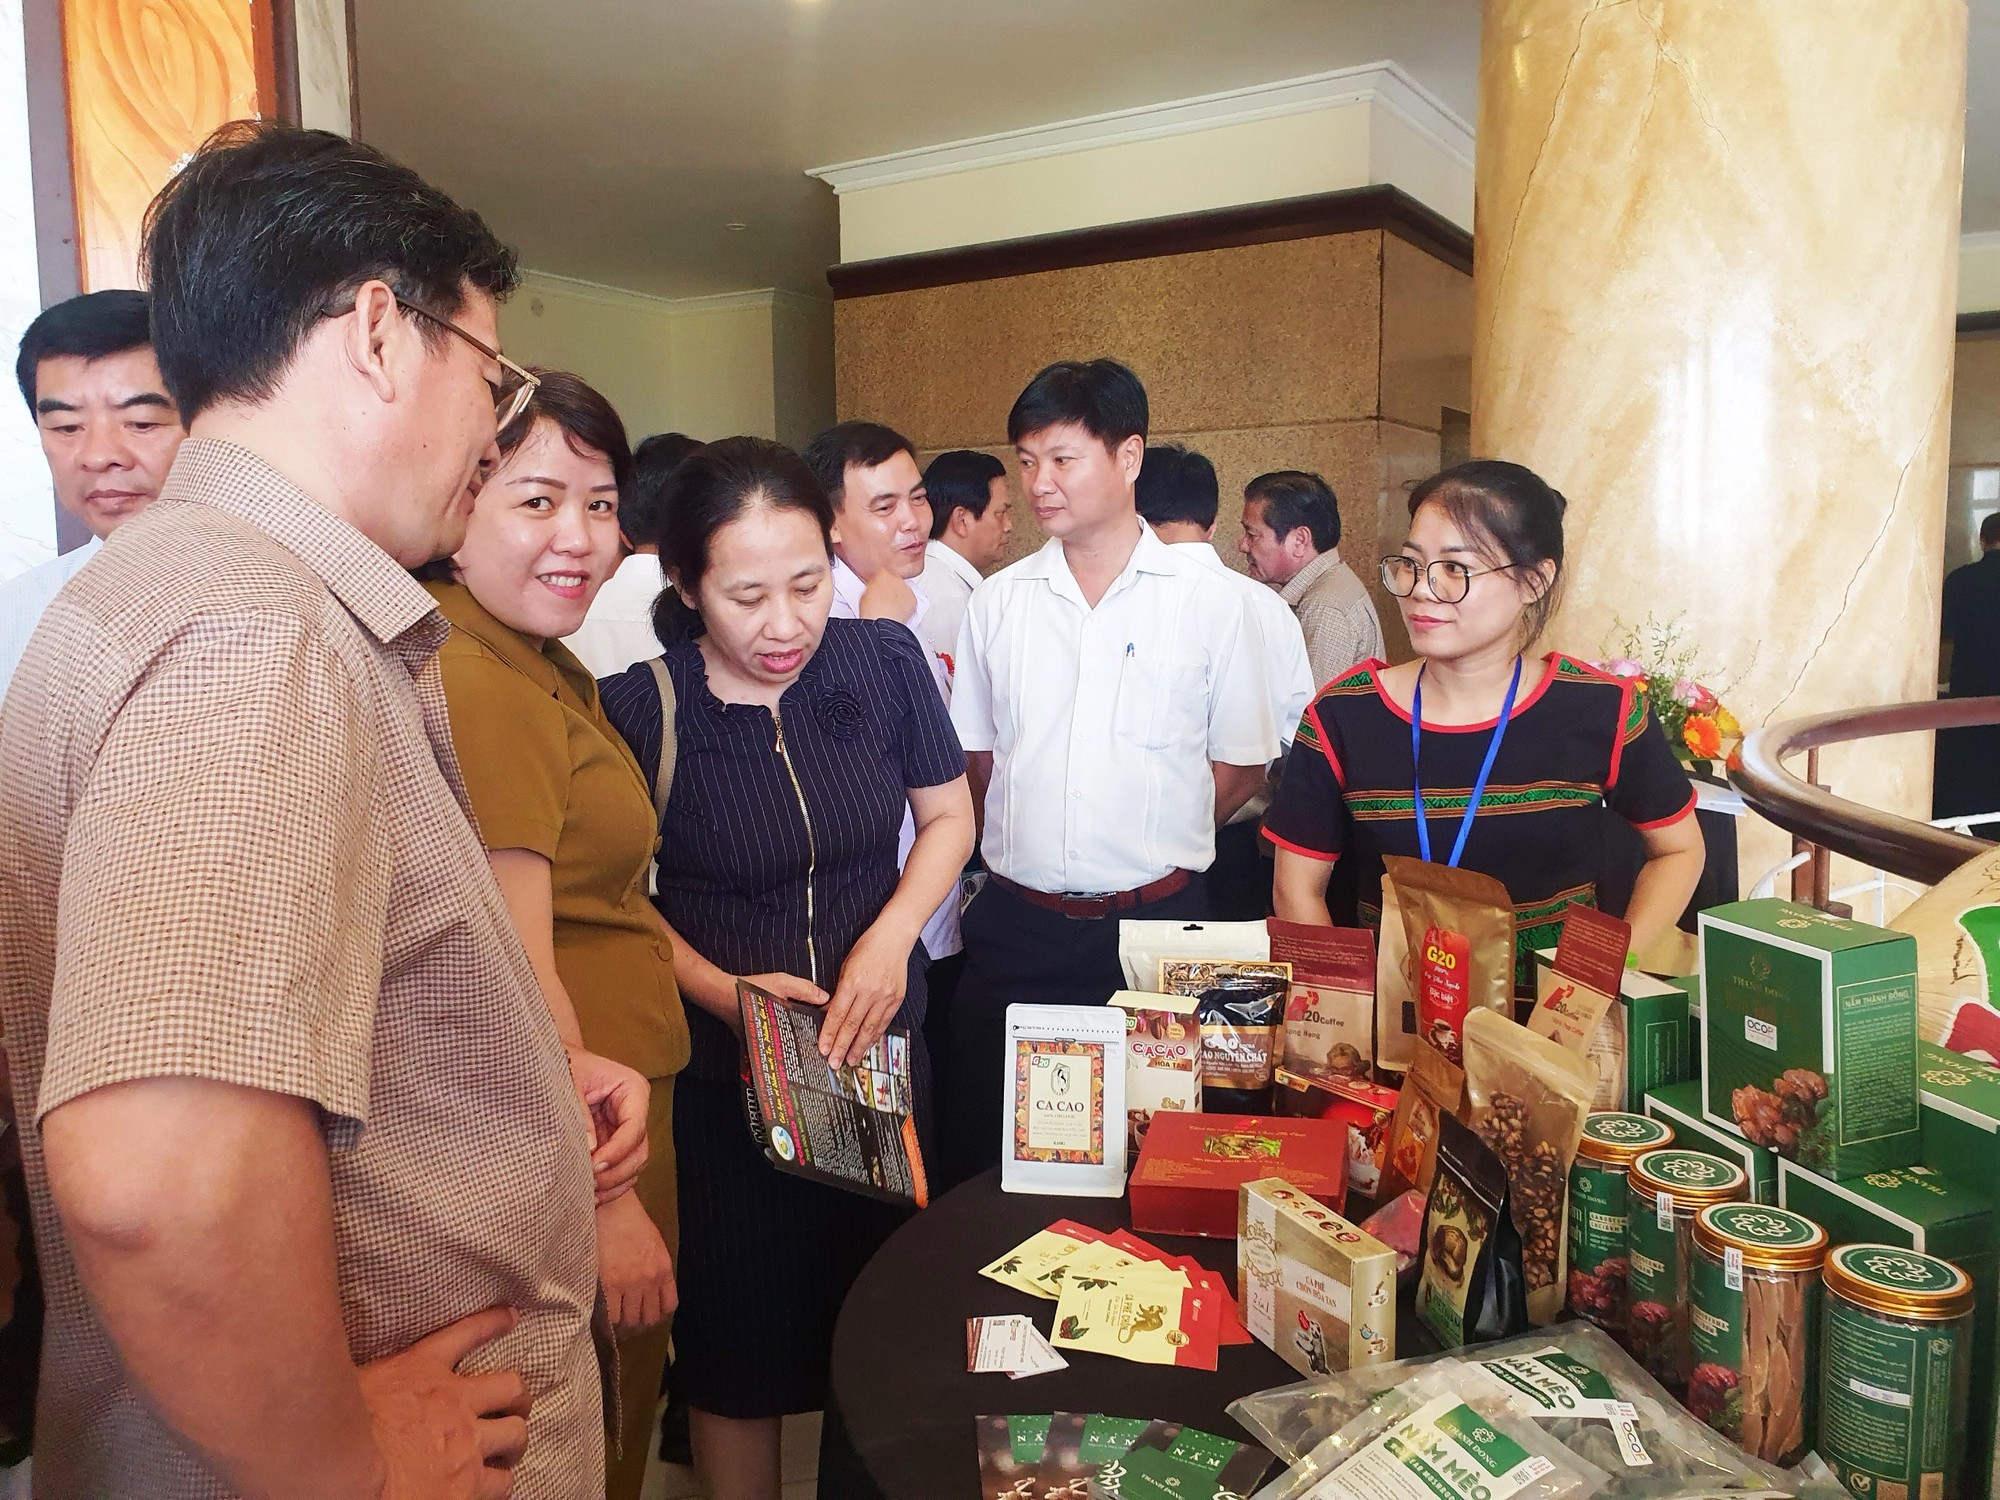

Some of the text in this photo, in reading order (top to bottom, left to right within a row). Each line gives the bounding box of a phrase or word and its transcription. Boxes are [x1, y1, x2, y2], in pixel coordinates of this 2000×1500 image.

[1427, 946, 1456, 969] G20
[1747, 1019, 1774, 1035] OCOP
[1132, 1042, 1187, 1060] CACAO
[1247, 1048, 1268, 1064] CHẤT
[1172, 1062, 1188, 1070] TAN
[1036, 1100, 1085, 1112] CA CAO
[1535, 1377, 1576, 1410] MÈO
[1017, 1431, 1045, 1443] NẤ
[1448, 1423, 1474, 1449] THANH
[1471, 1443, 1498, 1469] DONG
[1622, 1421, 1648, 1461] OCOP
[1398, 1422, 1448, 1465] NẤM
[1442, 1459, 1492, 1500] MÈO
